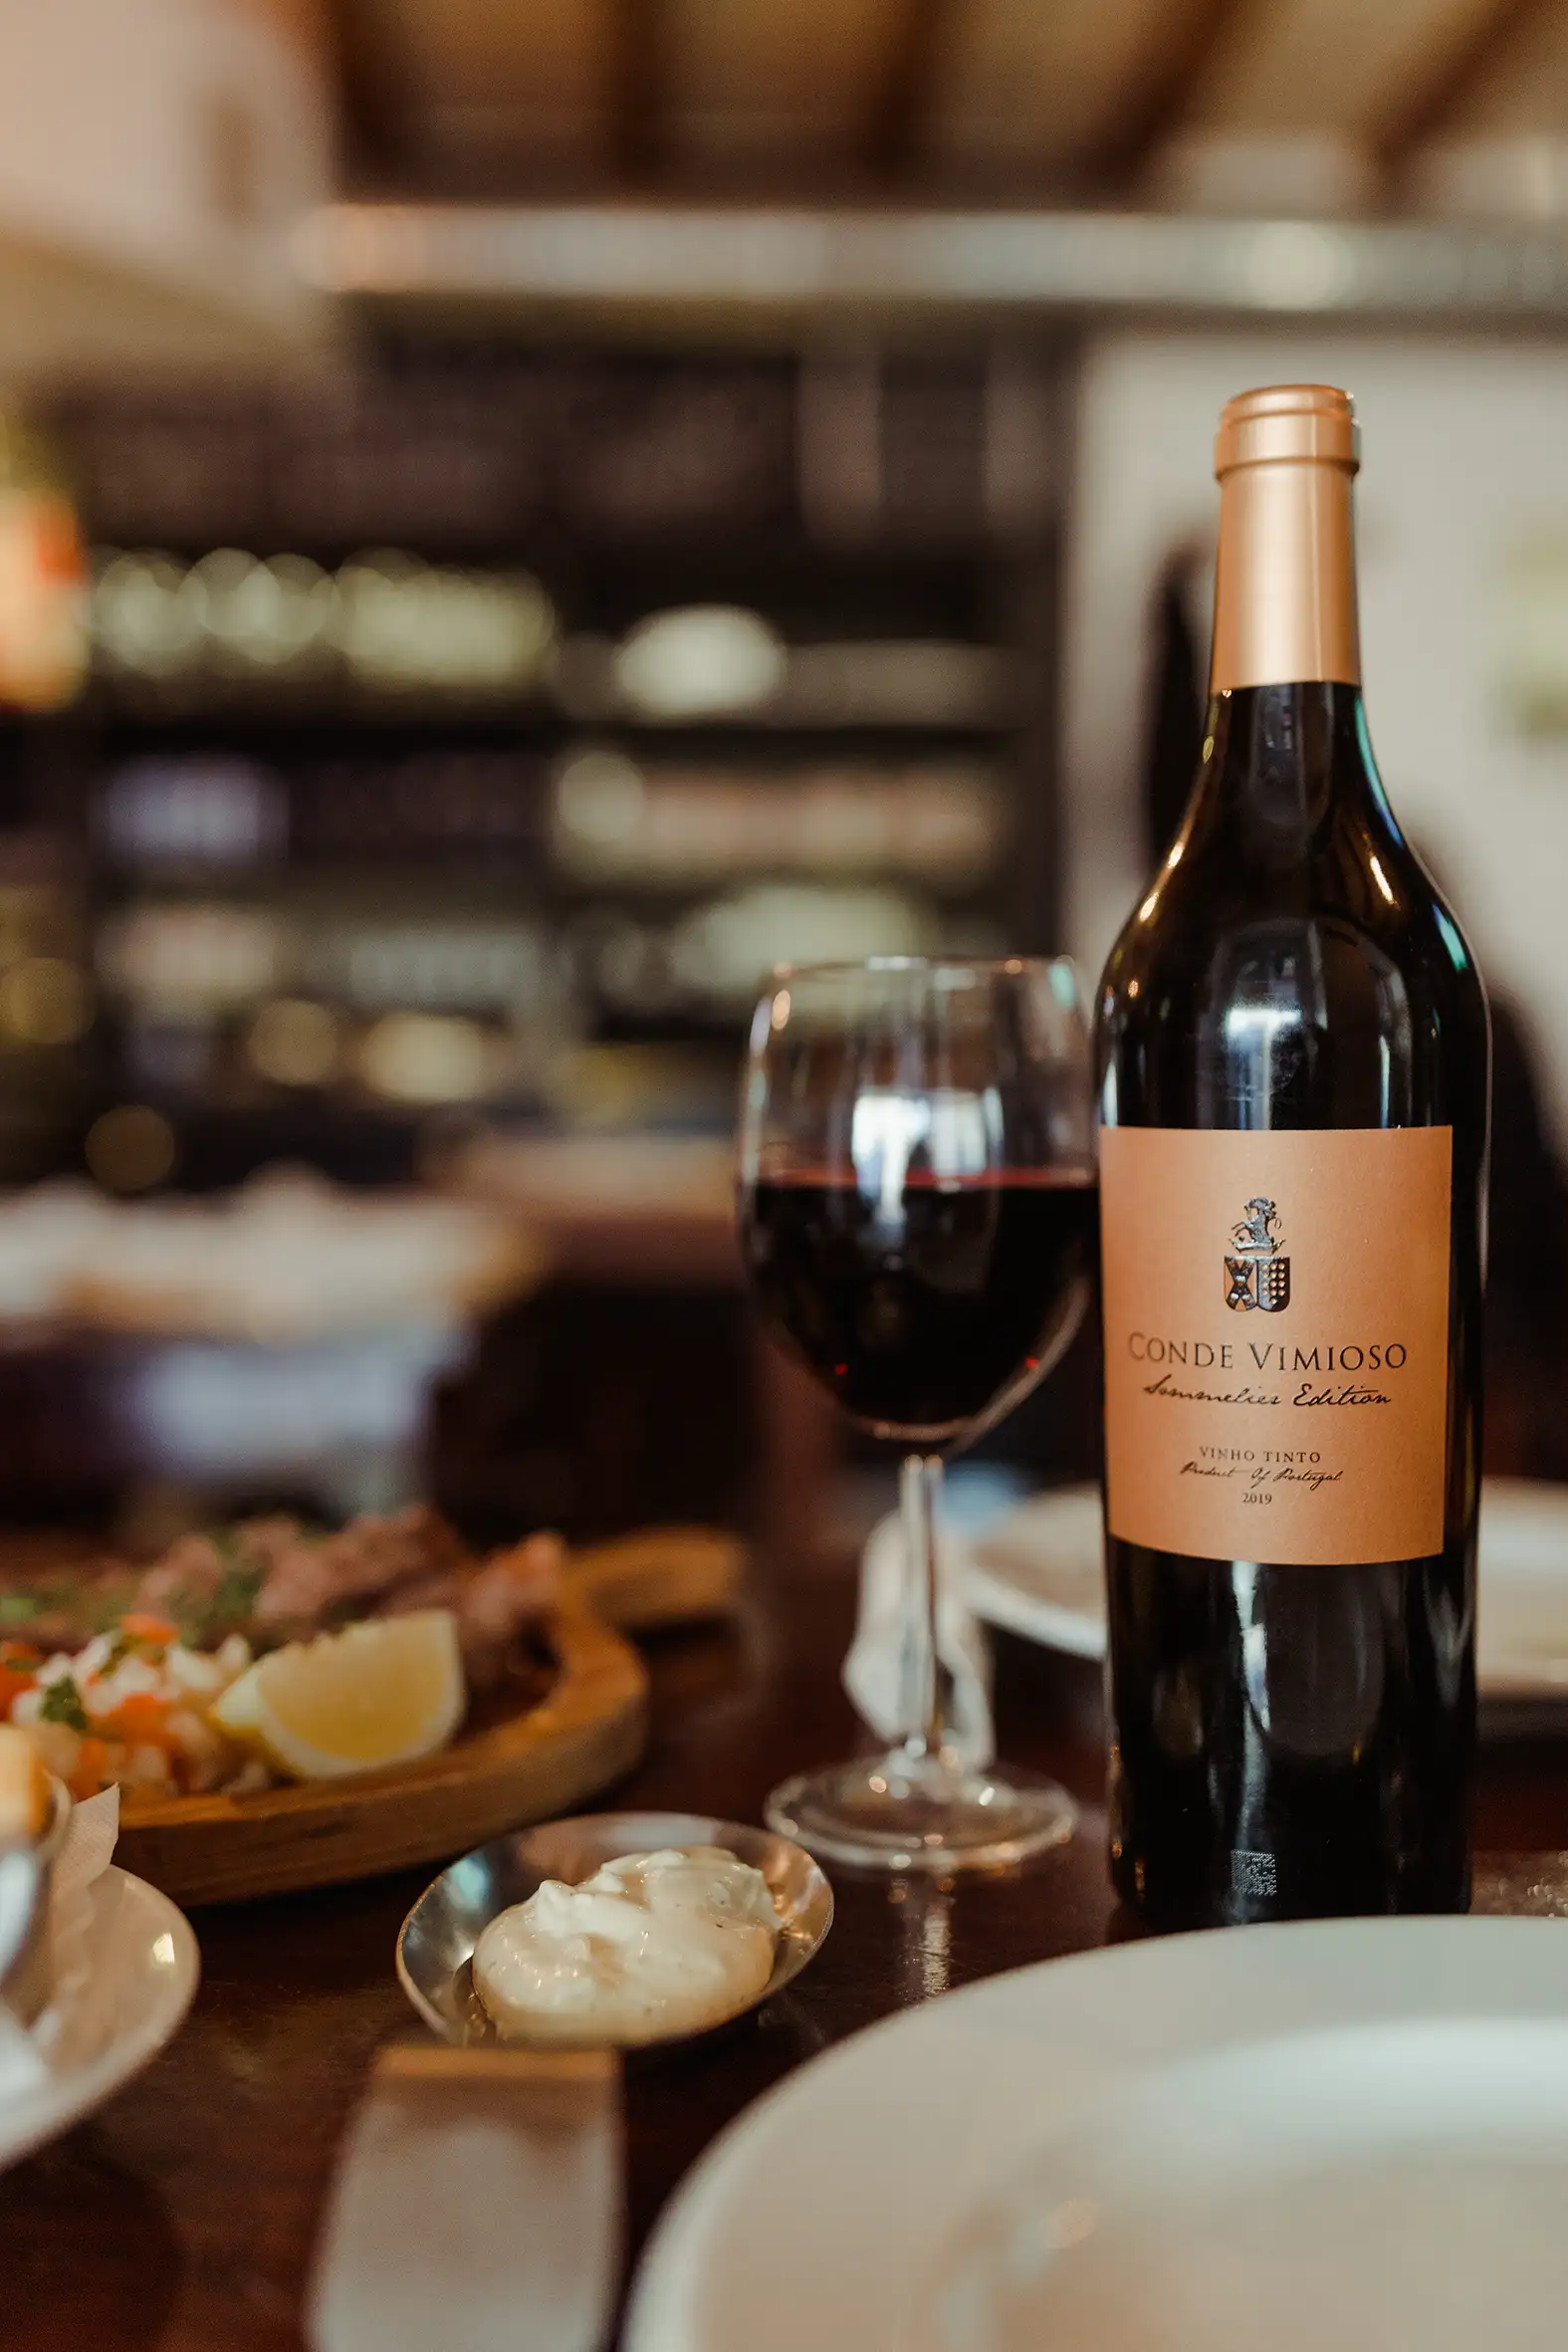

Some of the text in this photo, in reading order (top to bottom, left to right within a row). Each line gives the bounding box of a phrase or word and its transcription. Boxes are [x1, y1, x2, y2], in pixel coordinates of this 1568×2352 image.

[1128, 1331, 1408, 1371] CONDE VIMIOSO
[1143, 1374, 1392, 1407] Sommelier Edition
[1199, 1446, 1321, 1464] VINHO TINTO
[1180, 1461, 1343, 1491] Product Of Portugal
[1241, 1492, 1273, 1506] 2019
